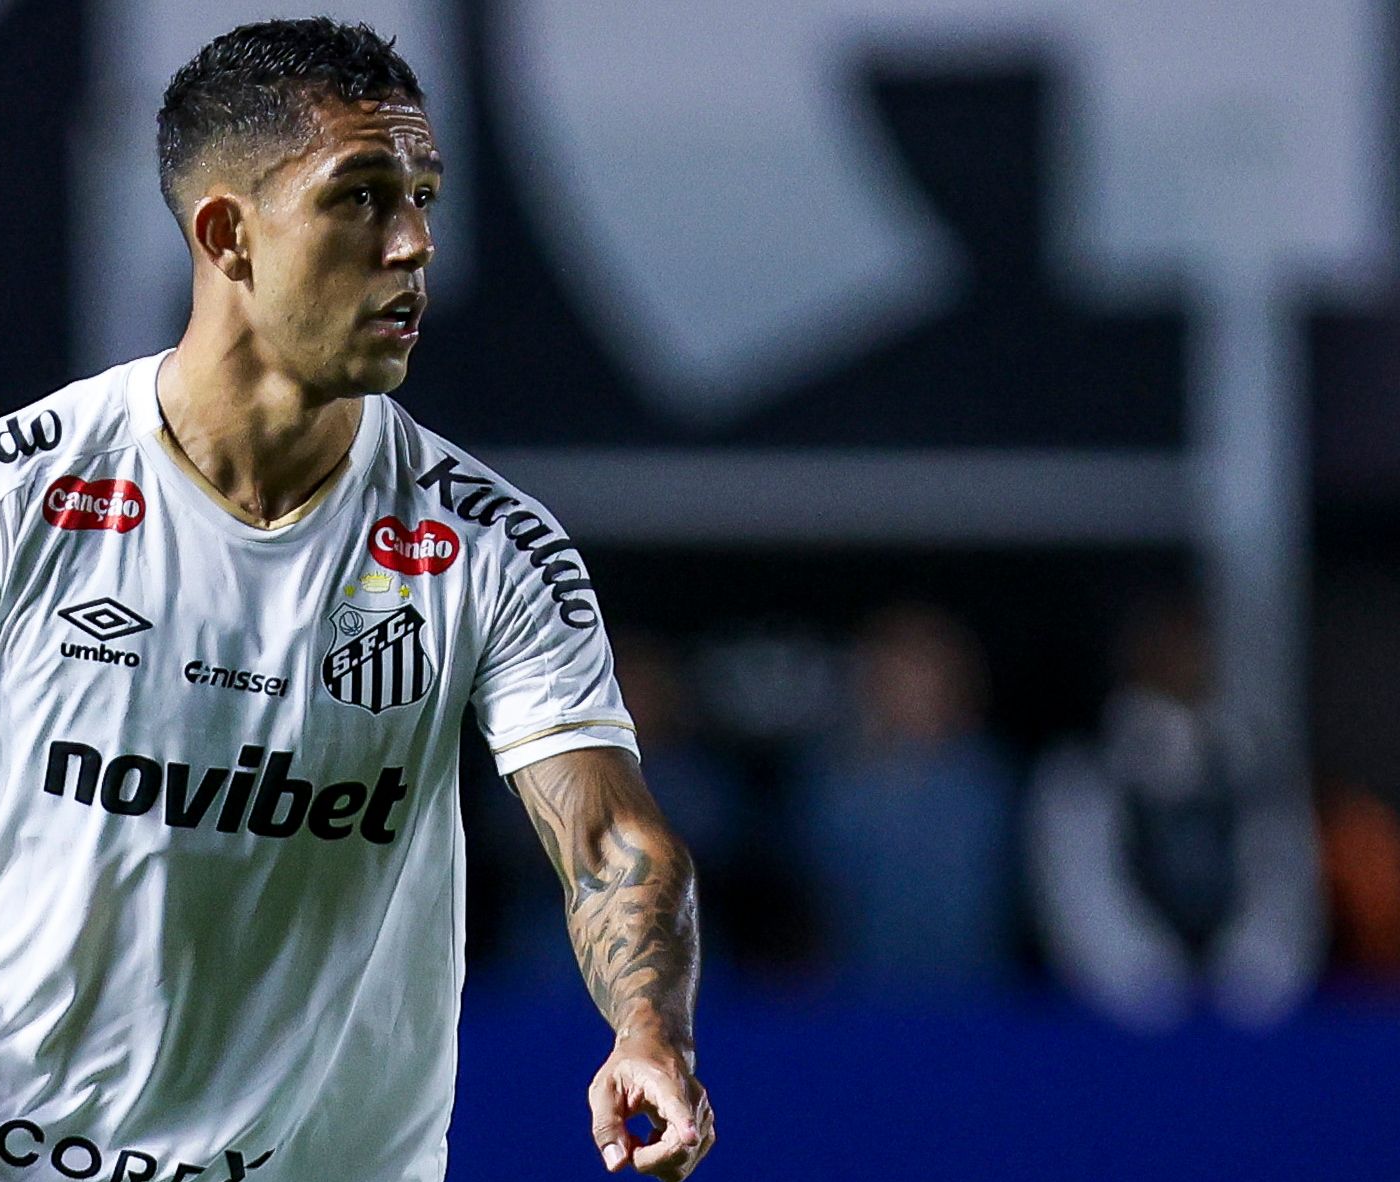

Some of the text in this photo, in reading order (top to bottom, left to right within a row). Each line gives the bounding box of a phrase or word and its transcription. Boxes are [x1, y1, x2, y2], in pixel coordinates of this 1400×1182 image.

[48, 487, 140, 522] Canção
[375, 526, 453, 560] Canão
[61, 641, 140, 667] umbro
[44, 740, 407, 844] novibet
